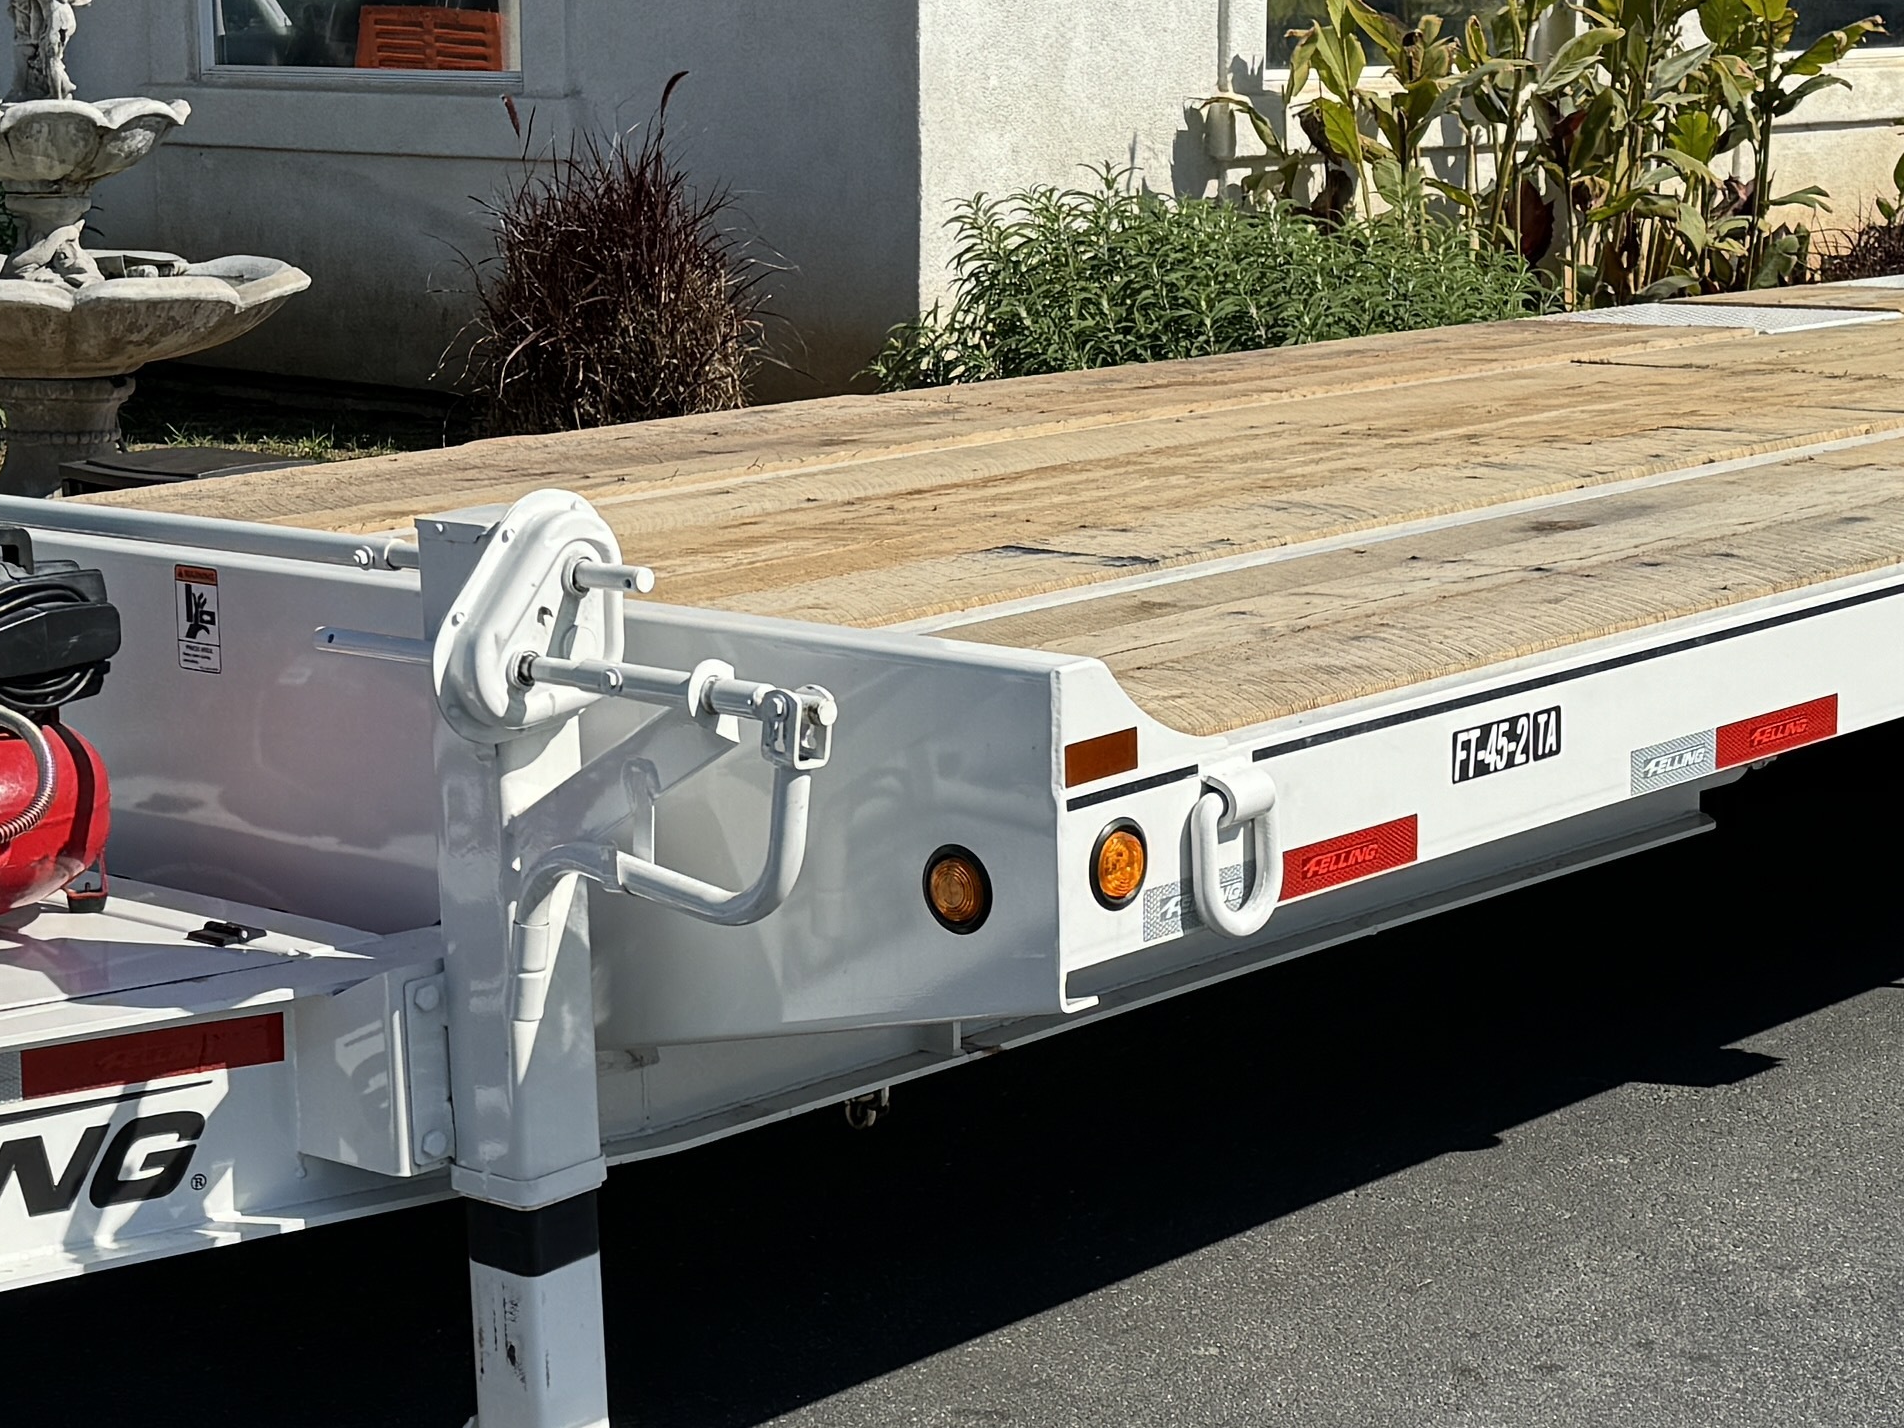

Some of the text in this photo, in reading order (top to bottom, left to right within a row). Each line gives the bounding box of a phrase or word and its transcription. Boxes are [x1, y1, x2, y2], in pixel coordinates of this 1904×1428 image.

[1749, 716, 1809, 746] FELLING
[1642, 742, 1706, 777] FELLING
[1302, 841, 1379, 878] FELLING
